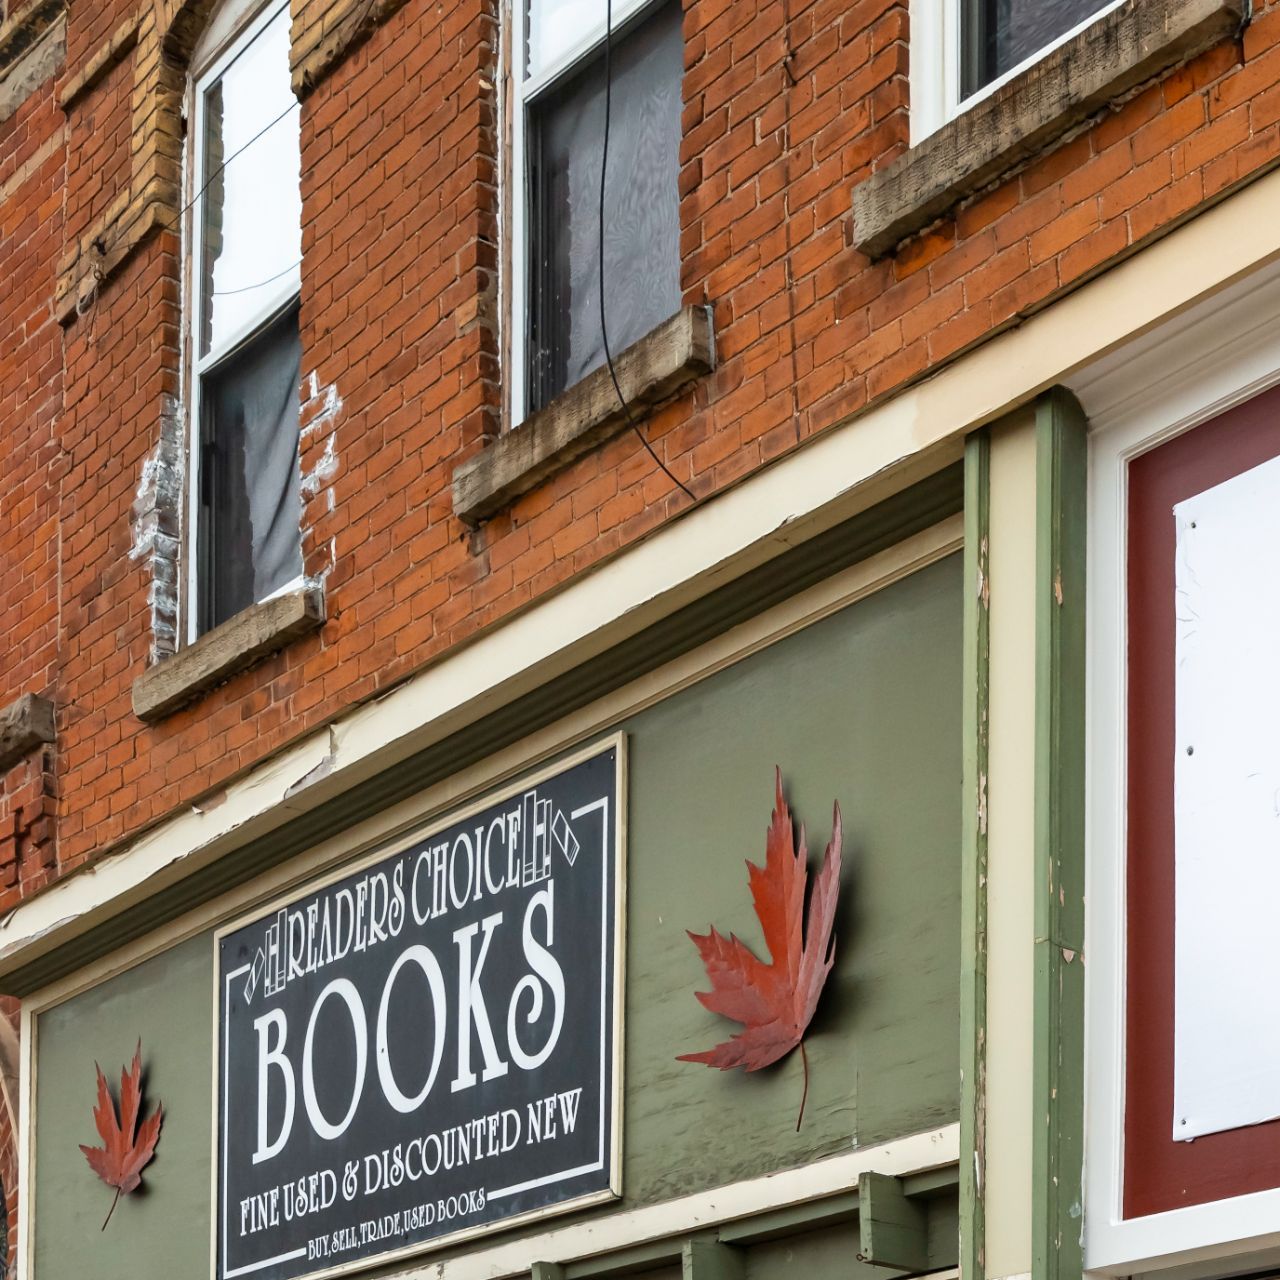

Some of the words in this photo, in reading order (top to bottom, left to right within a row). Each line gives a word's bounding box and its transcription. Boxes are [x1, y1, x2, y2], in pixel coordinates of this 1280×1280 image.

[287, 861, 405, 982] READERS
[412, 804, 521, 925] CHOICE
[252, 879, 565, 1164] BOOKS
[240, 1186, 279, 1236] FINE
[283, 1169, 336, 1219] USED
[342, 1161, 359, 1199] &
[364, 1109, 521, 1194] DISCOUNTED
[526, 1088, 582, 1144] NEW
[437, 1187, 485, 1222] BOOKS
